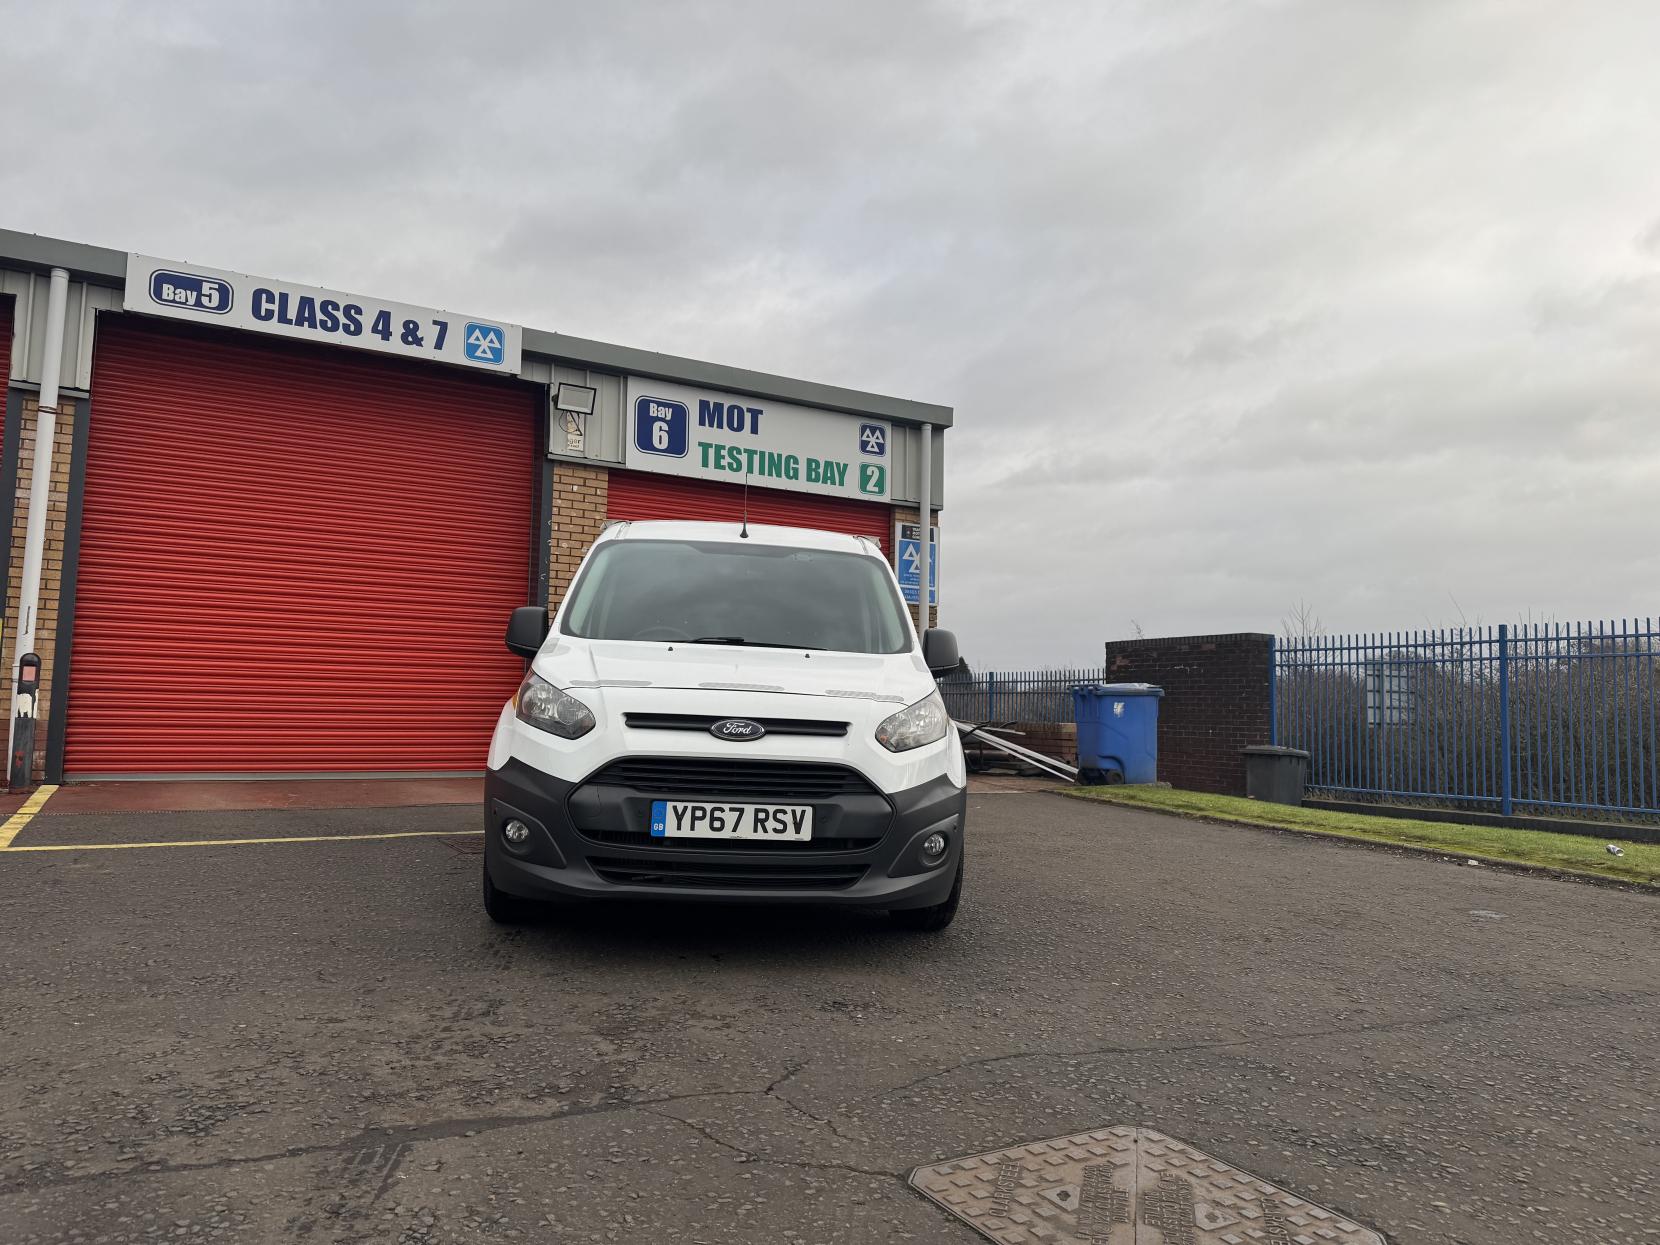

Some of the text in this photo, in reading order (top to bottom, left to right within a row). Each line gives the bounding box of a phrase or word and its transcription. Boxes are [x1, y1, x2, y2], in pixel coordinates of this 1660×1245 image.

[161, 281, 220, 308] Bay 5
[251, 287, 449, 351] CLASS 4 & 7
[650, 402, 673, 420] Bay
[698, 398, 764, 435] MOT
[652, 421, 669, 449] 6
[697, 441, 849, 487] TESTING BAY
[866, 465, 880, 493] 2
[723, 722, 752, 734] Ford
[653, 823, 664, 831] GB
[672, 805, 806, 835] YP67 RSV
[988, 1161, 1020, 1218] CLARKSTEEL
